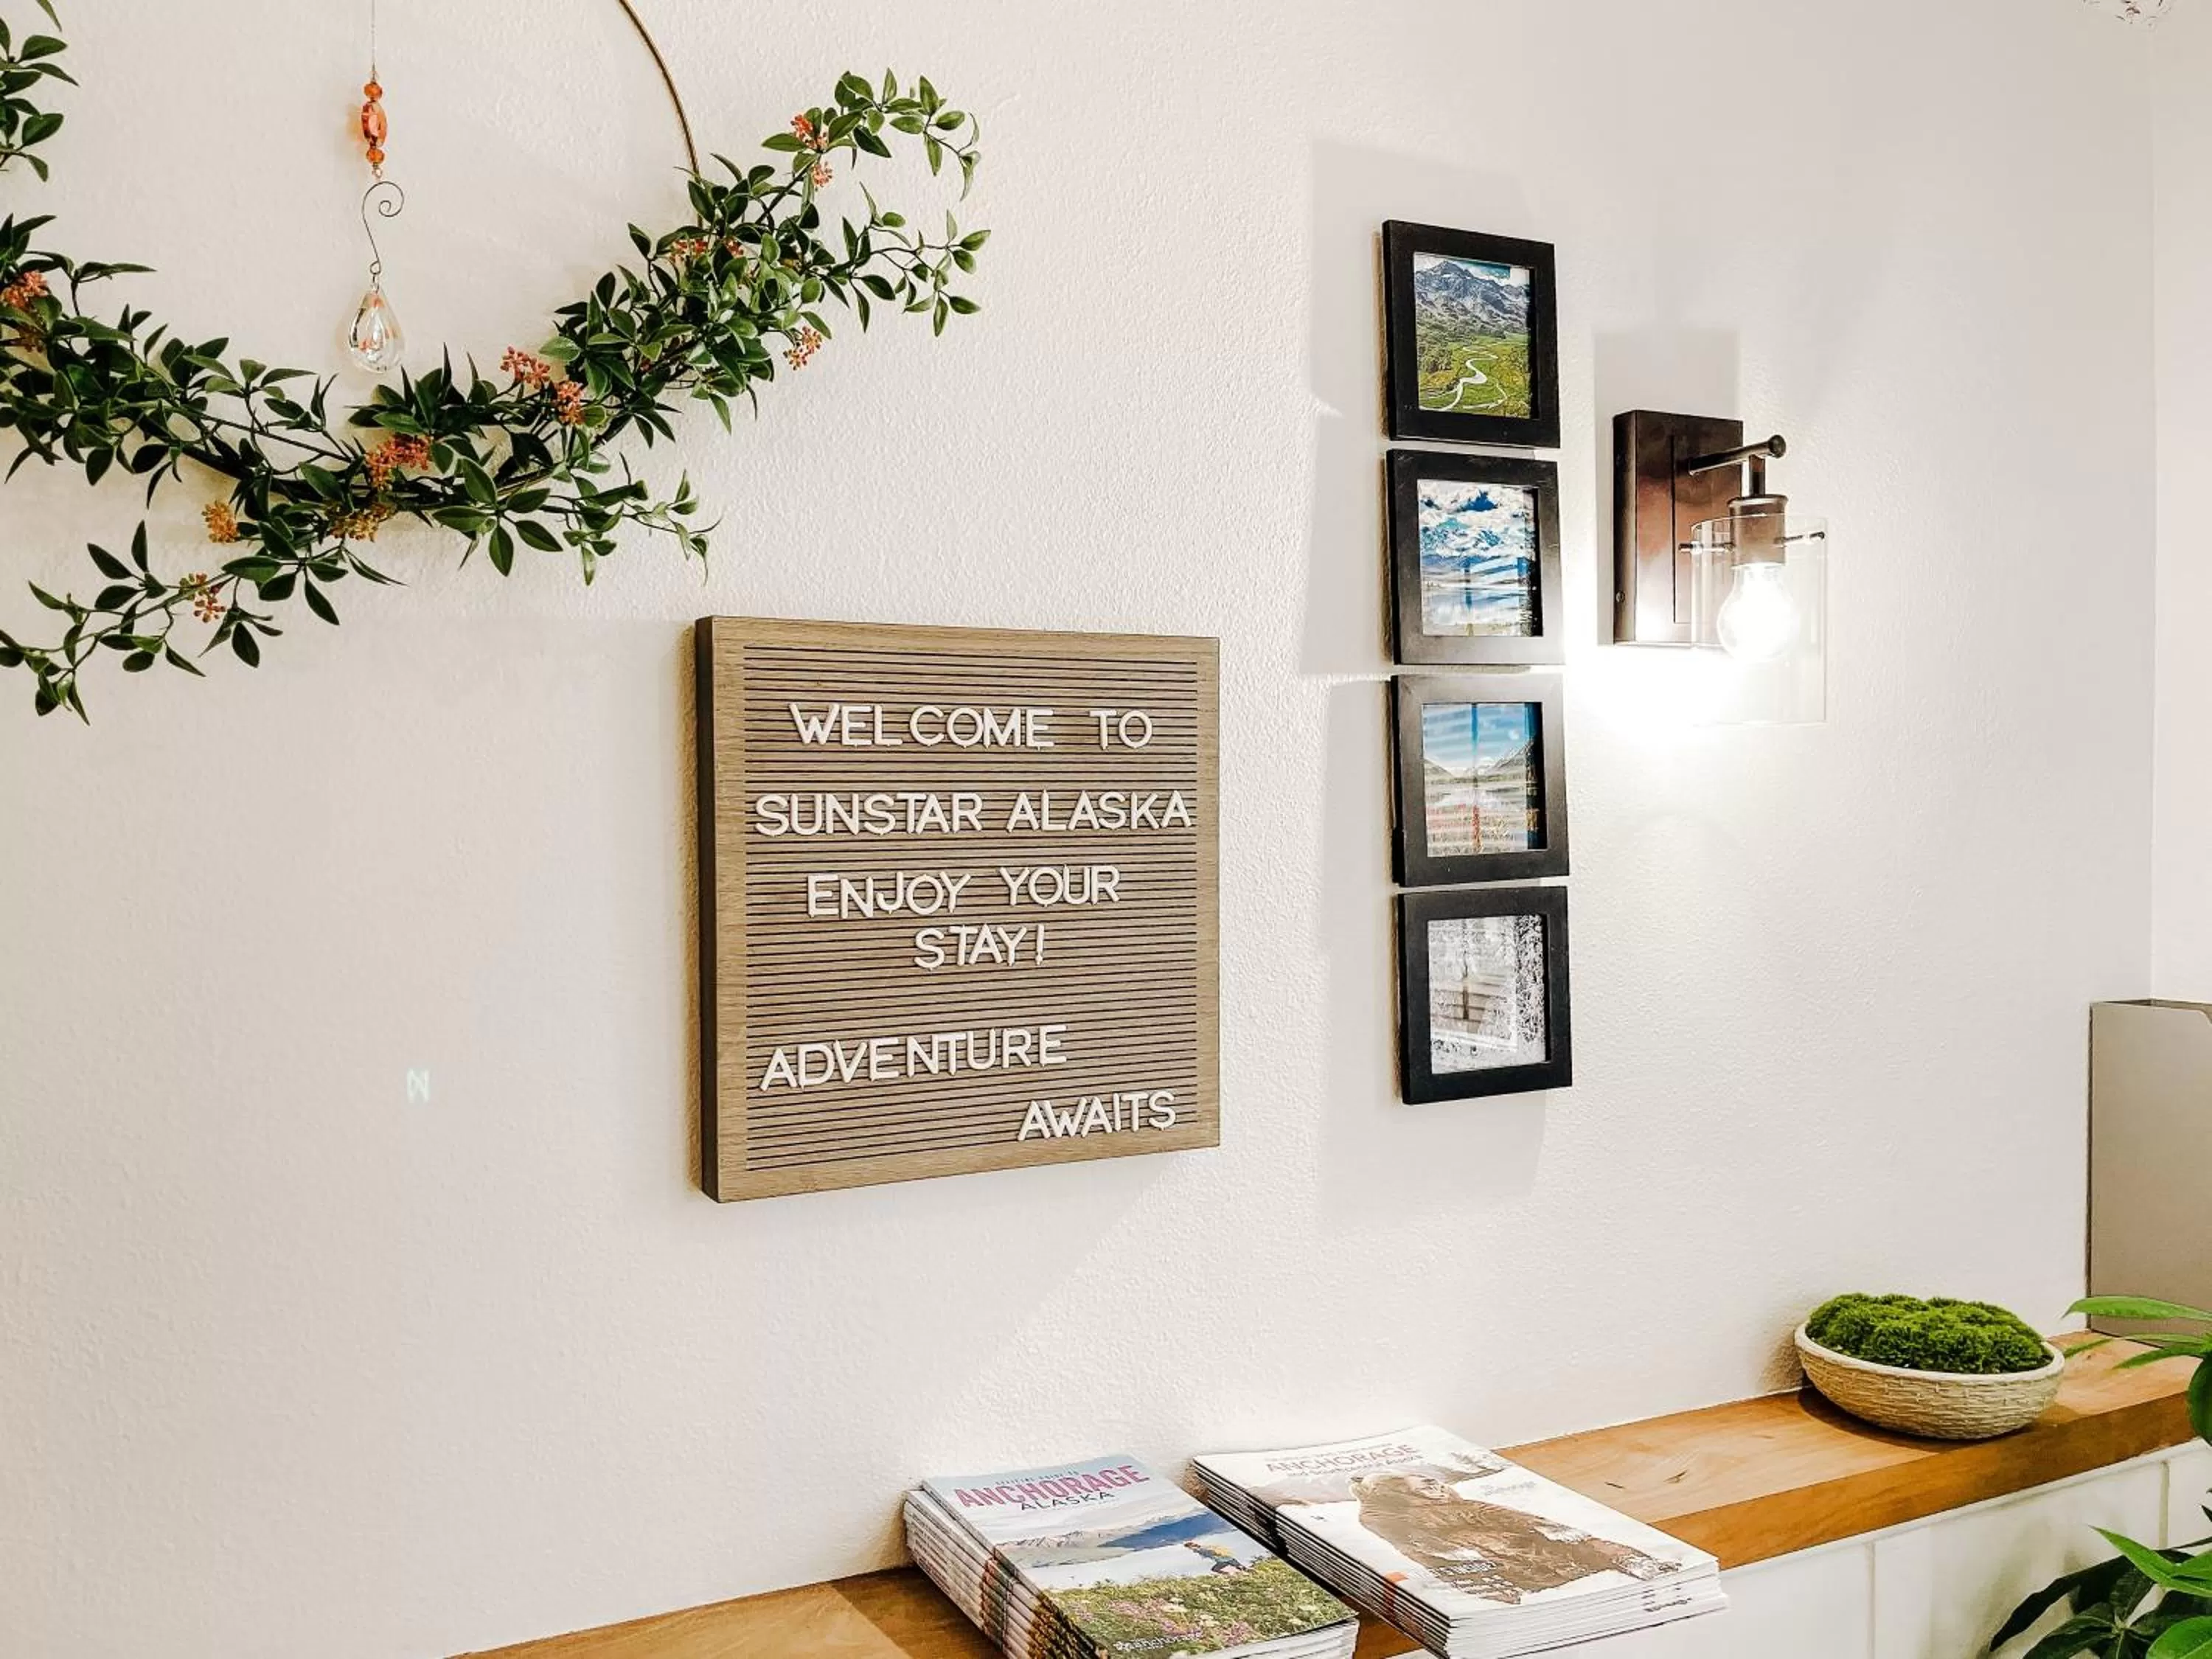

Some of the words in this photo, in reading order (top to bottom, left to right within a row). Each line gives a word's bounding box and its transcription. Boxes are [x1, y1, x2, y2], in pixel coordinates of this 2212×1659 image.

[790, 702, 1055, 750] WELCOME
[1090, 709, 1155, 749] TO
[757, 793, 984, 836] SUNSTAR
[1007, 790, 1192, 832] ALASKA
[808, 871, 972, 919] ENJOY
[999, 865, 1121, 907] YOUR
[915, 924, 1046, 970] STAY!
[760, 1024, 1068, 1091] ADVENTURE
[1018, 1090, 1177, 1141] AWAITS
[1266, 1444, 1418, 1472] ANCHORAGE
[954, 1465, 1150, 1507] ANCHORAGE
[1021, 1491, 1116, 1511] ALASKA
